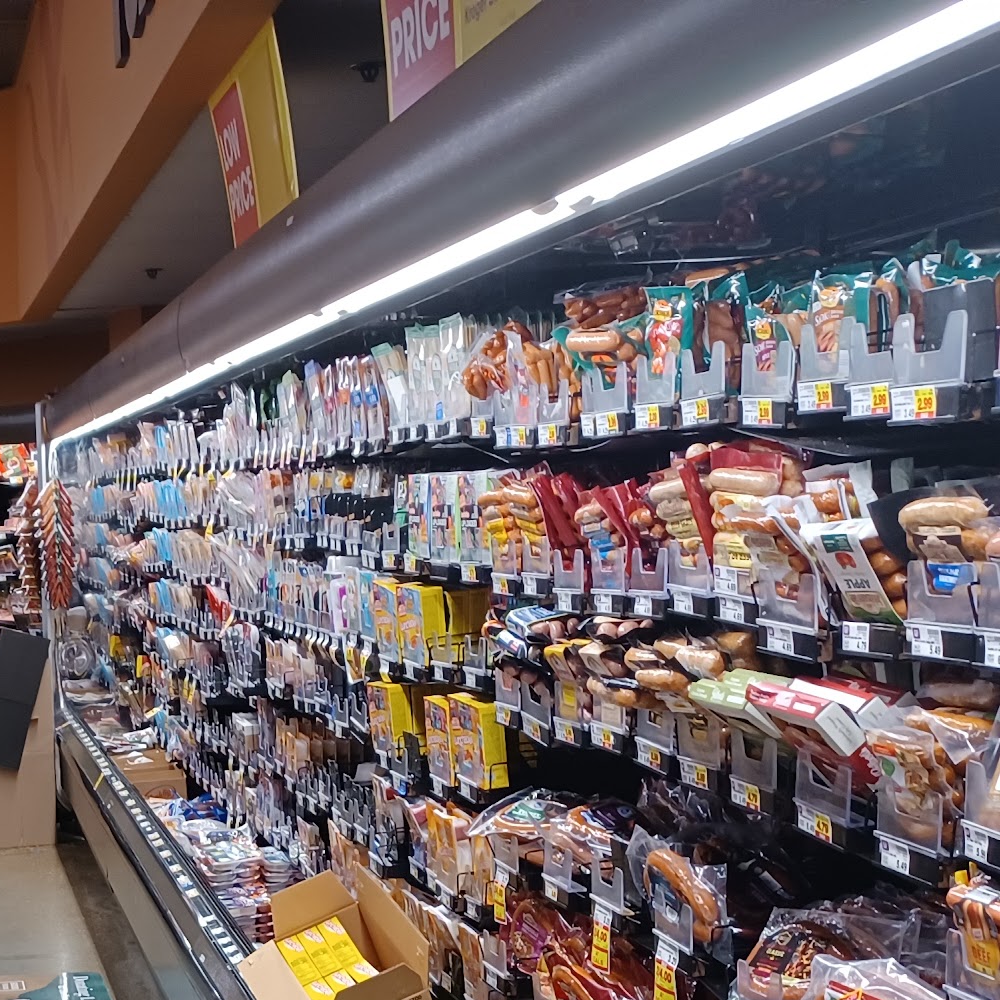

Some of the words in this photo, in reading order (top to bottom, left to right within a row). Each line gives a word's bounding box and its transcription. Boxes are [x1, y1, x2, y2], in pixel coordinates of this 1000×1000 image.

[391, 0, 450, 78] PRICE
[219, 118, 241, 172] LOW
[228, 165, 255, 223] PRICE
[844, 579, 870, 589] APPLE
